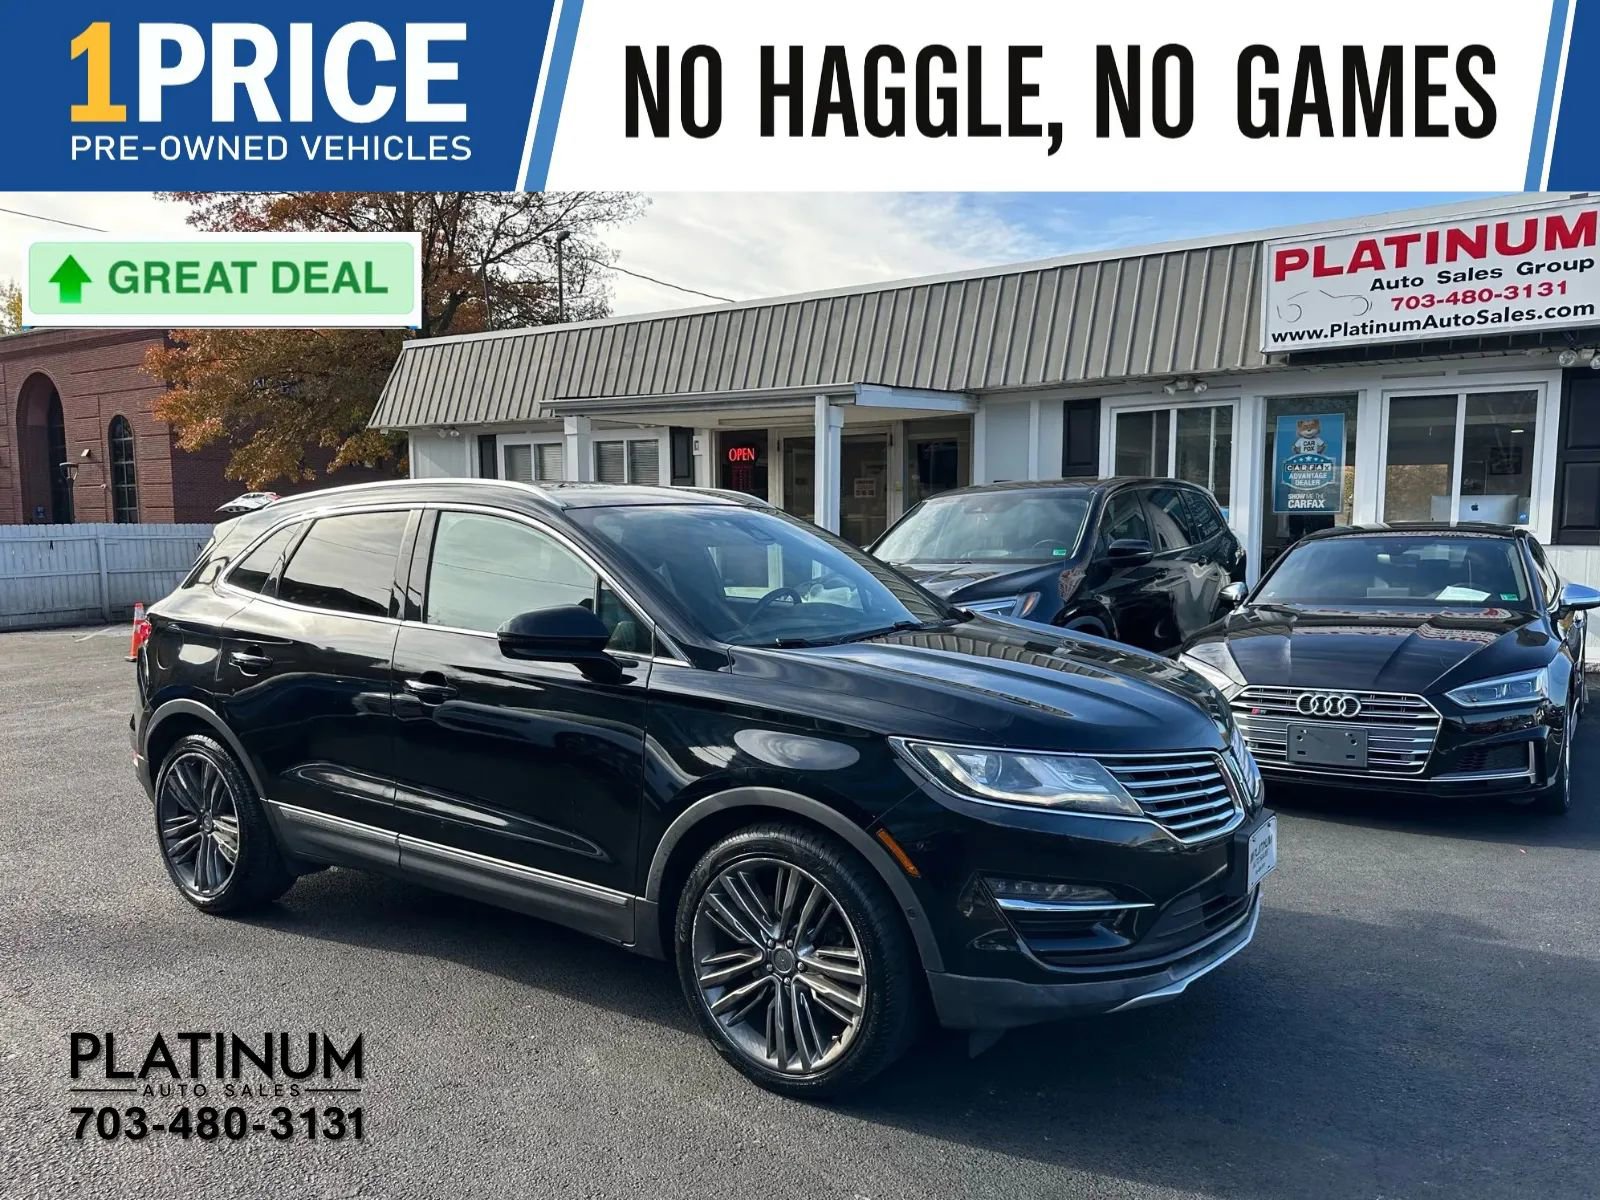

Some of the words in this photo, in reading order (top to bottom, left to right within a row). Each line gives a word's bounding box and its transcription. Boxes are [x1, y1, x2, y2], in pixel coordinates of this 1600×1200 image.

[1275, 211, 1598, 282] PLATINUM
[1370, 275, 1424, 291] Auto
[1437, 267, 1503, 284] Sales
[1516, 258, 1594, 275] Group
[1391, 280, 1567, 311] 703-480-3131
[1271, 304, 1595, 343] www.PlatinumAutoSales.com
[728, 448, 755, 461] OPEN
[1286, 463, 1331, 472] CARFAX
[1288, 500, 1325, 509] CARFAX
